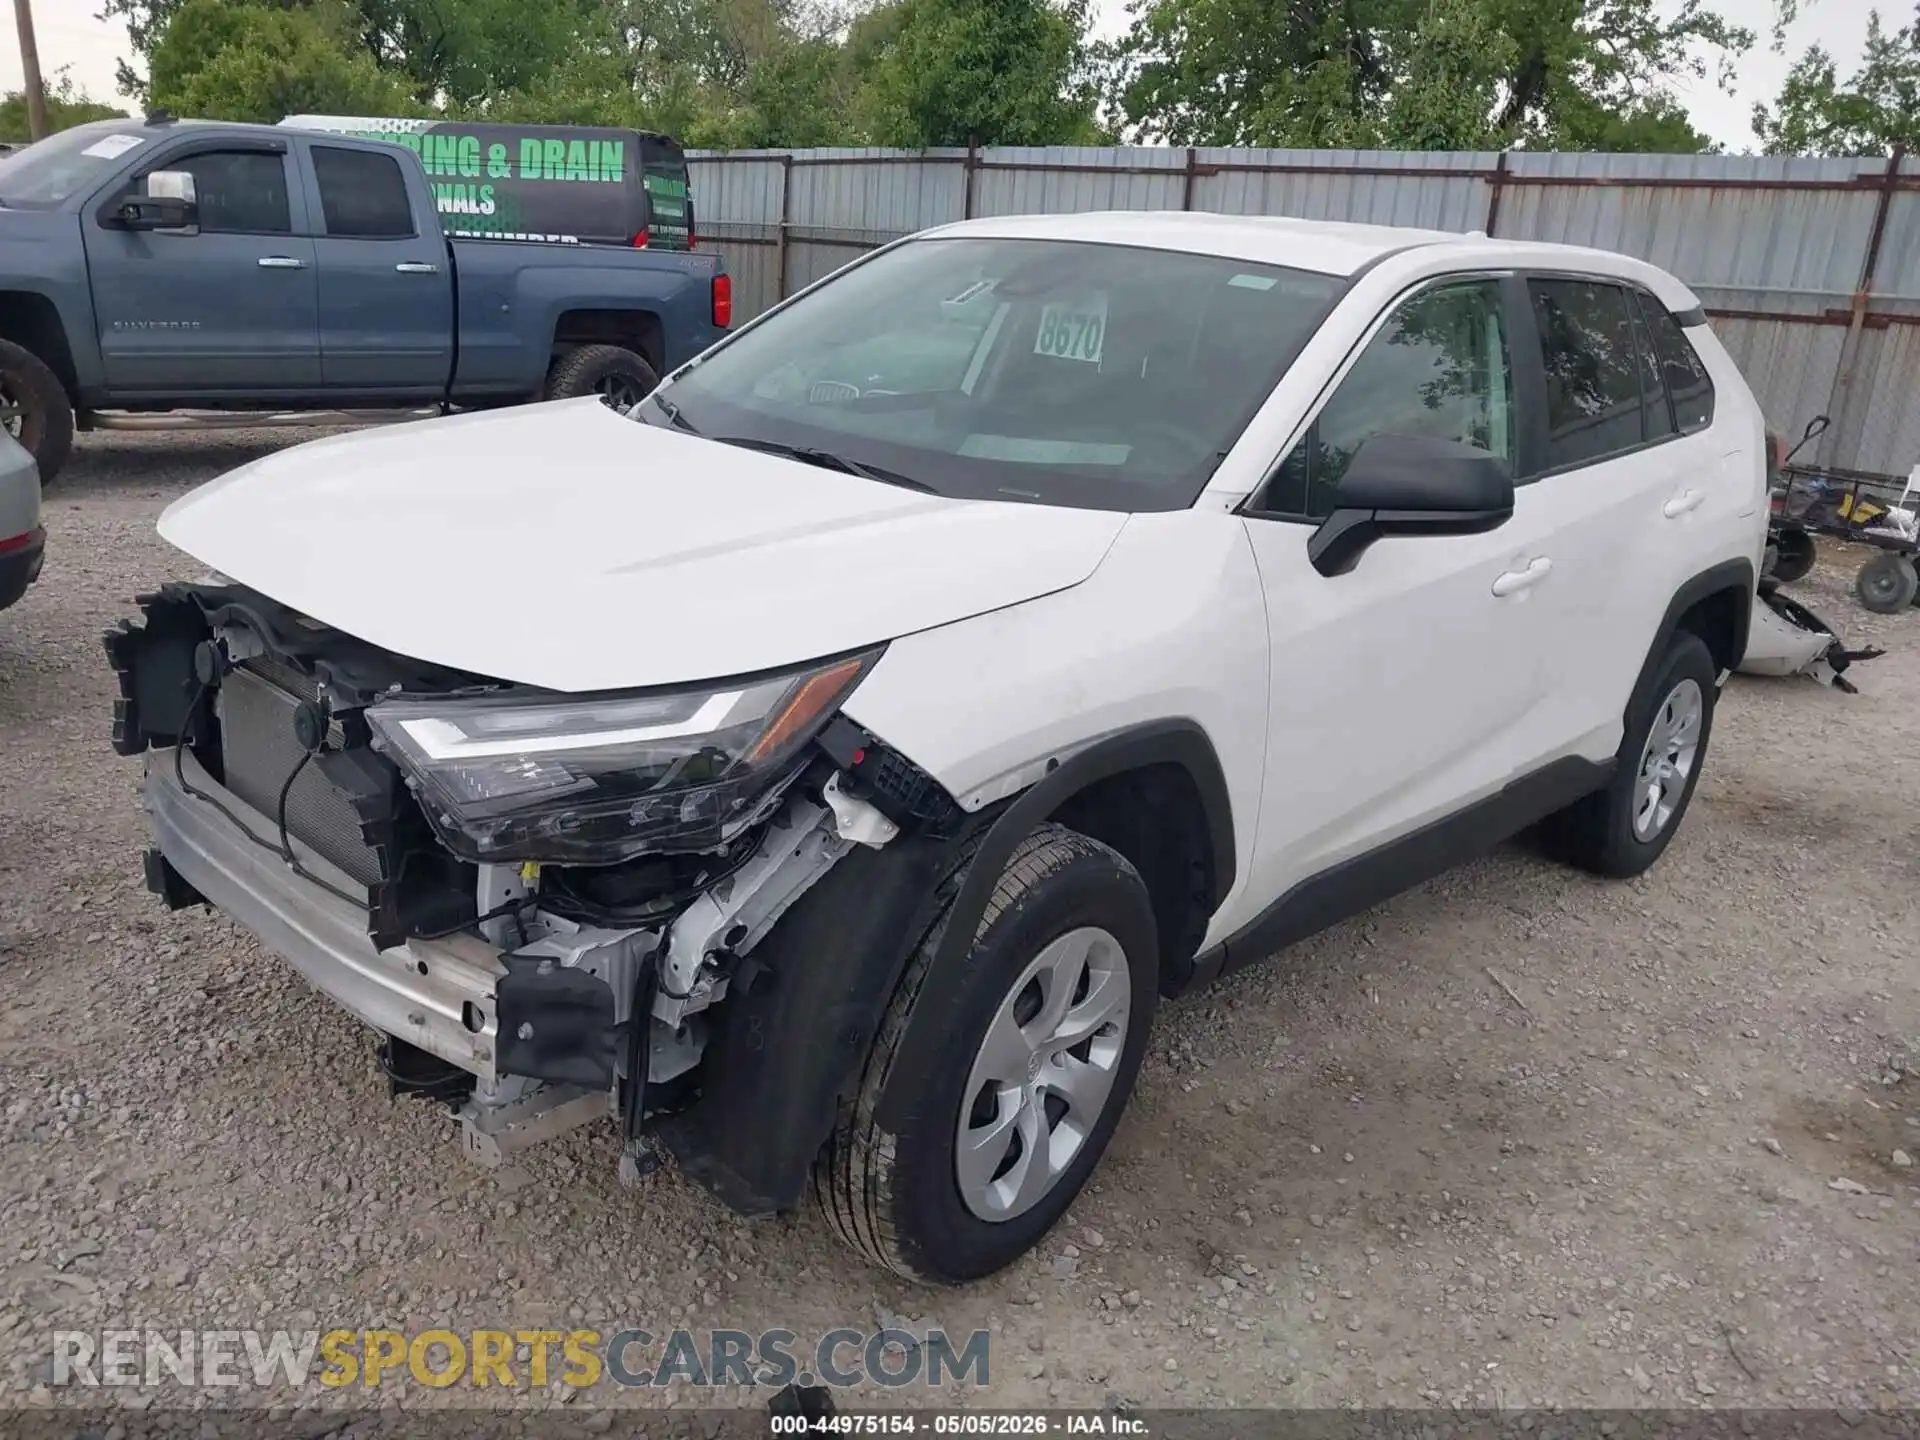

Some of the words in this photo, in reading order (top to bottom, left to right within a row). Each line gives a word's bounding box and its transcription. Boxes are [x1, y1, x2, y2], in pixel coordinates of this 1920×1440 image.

[488, 143, 512, 178] &
[521, 138, 624, 182] DRAIN
[432, 182, 496, 215] NALS
[1041, 307, 1101, 358] 8670
